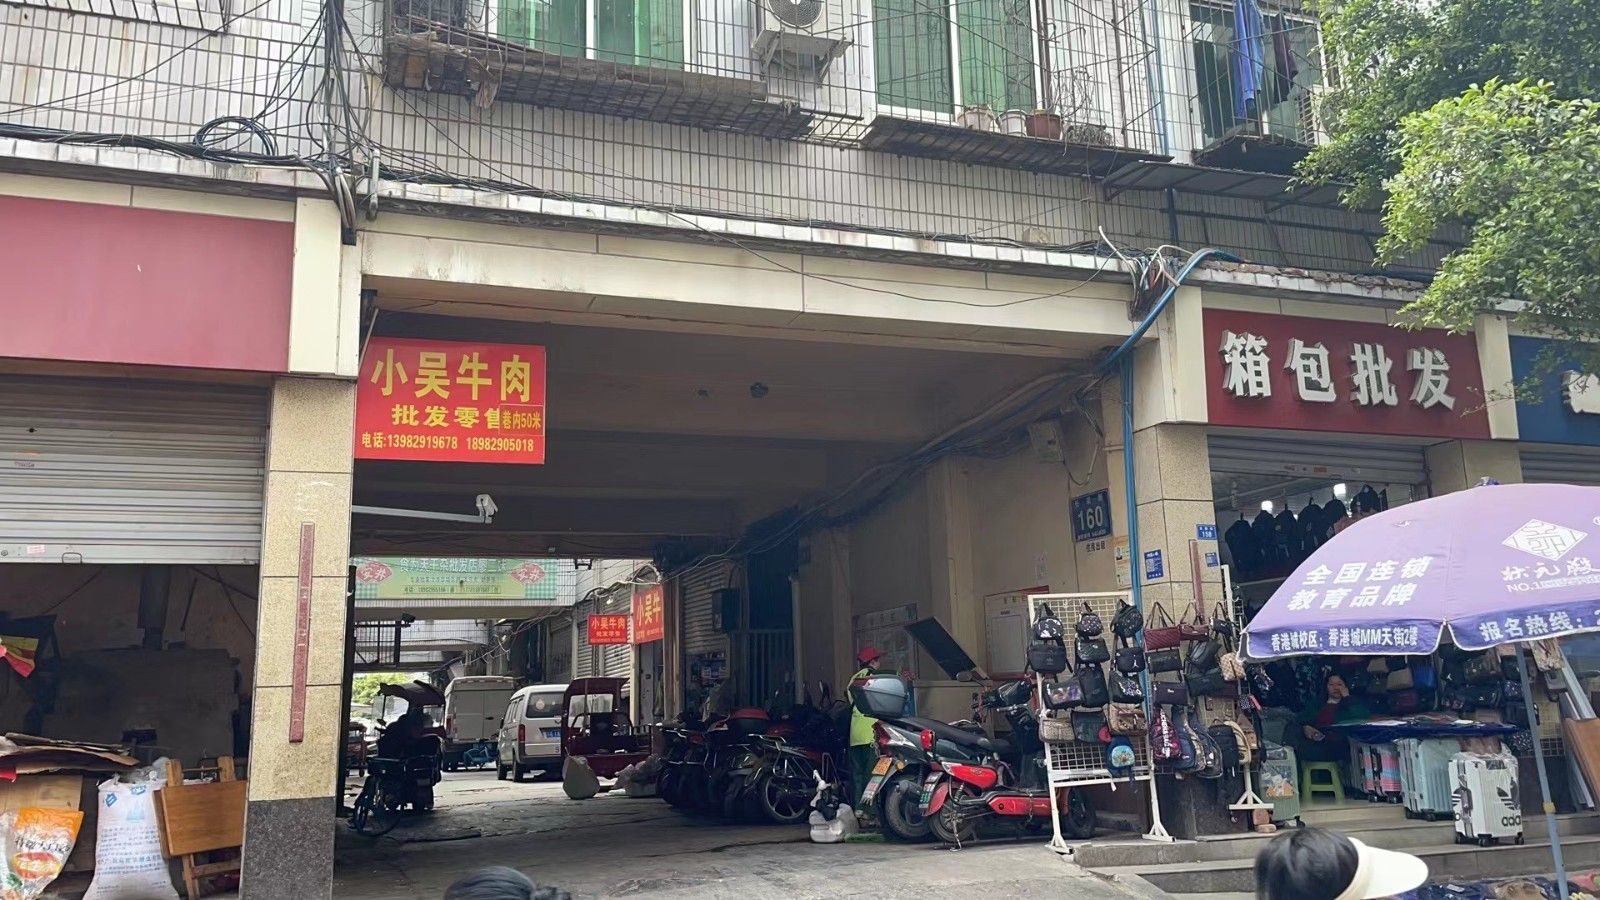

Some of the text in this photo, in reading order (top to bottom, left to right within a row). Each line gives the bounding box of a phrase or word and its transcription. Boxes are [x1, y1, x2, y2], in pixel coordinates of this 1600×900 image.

[370, 349, 531, 402] 小吴牛肉
[1219, 329, 1456, 411] 箱包批发
[391, 404, 500, 429] 批发零售
[502, 411, 541, 430] 巷内50米
[466, 437, 534, 452] 18982905018
[1078, 505, 1103, 530] 160
[1302, 556, 1433, 586] 全国连锁
[1287, 582, 1418, 611] 教育品牌
[591, 617, 625, 629] 小吴牛肉
